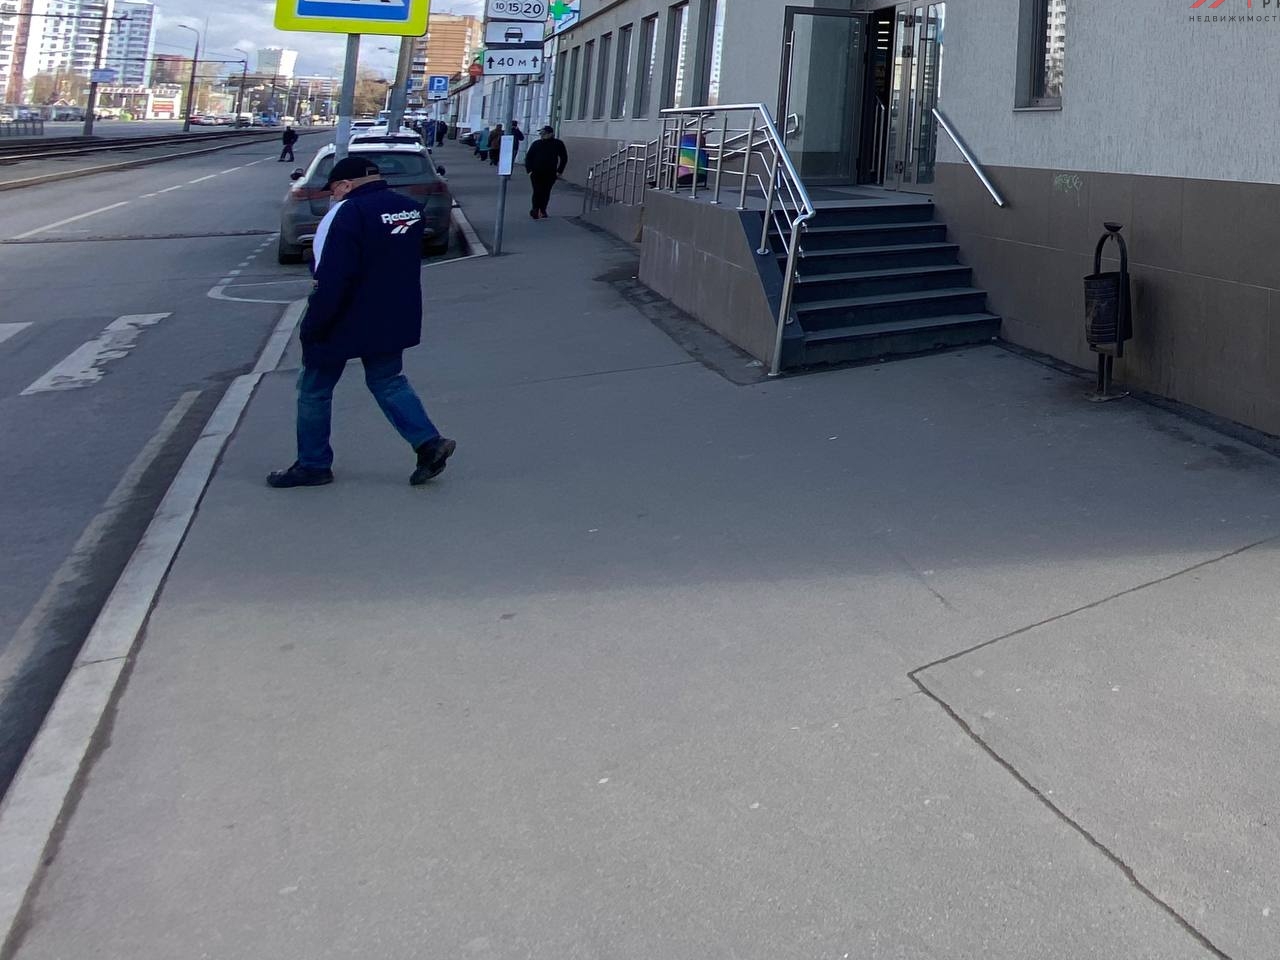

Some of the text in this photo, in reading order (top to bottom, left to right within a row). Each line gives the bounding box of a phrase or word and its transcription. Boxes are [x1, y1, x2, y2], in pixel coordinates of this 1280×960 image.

[495, 2, 541, 14] 10 15 20
[497, 57, 514, 67] 40
[380, 209, 421, 224] Reebok
